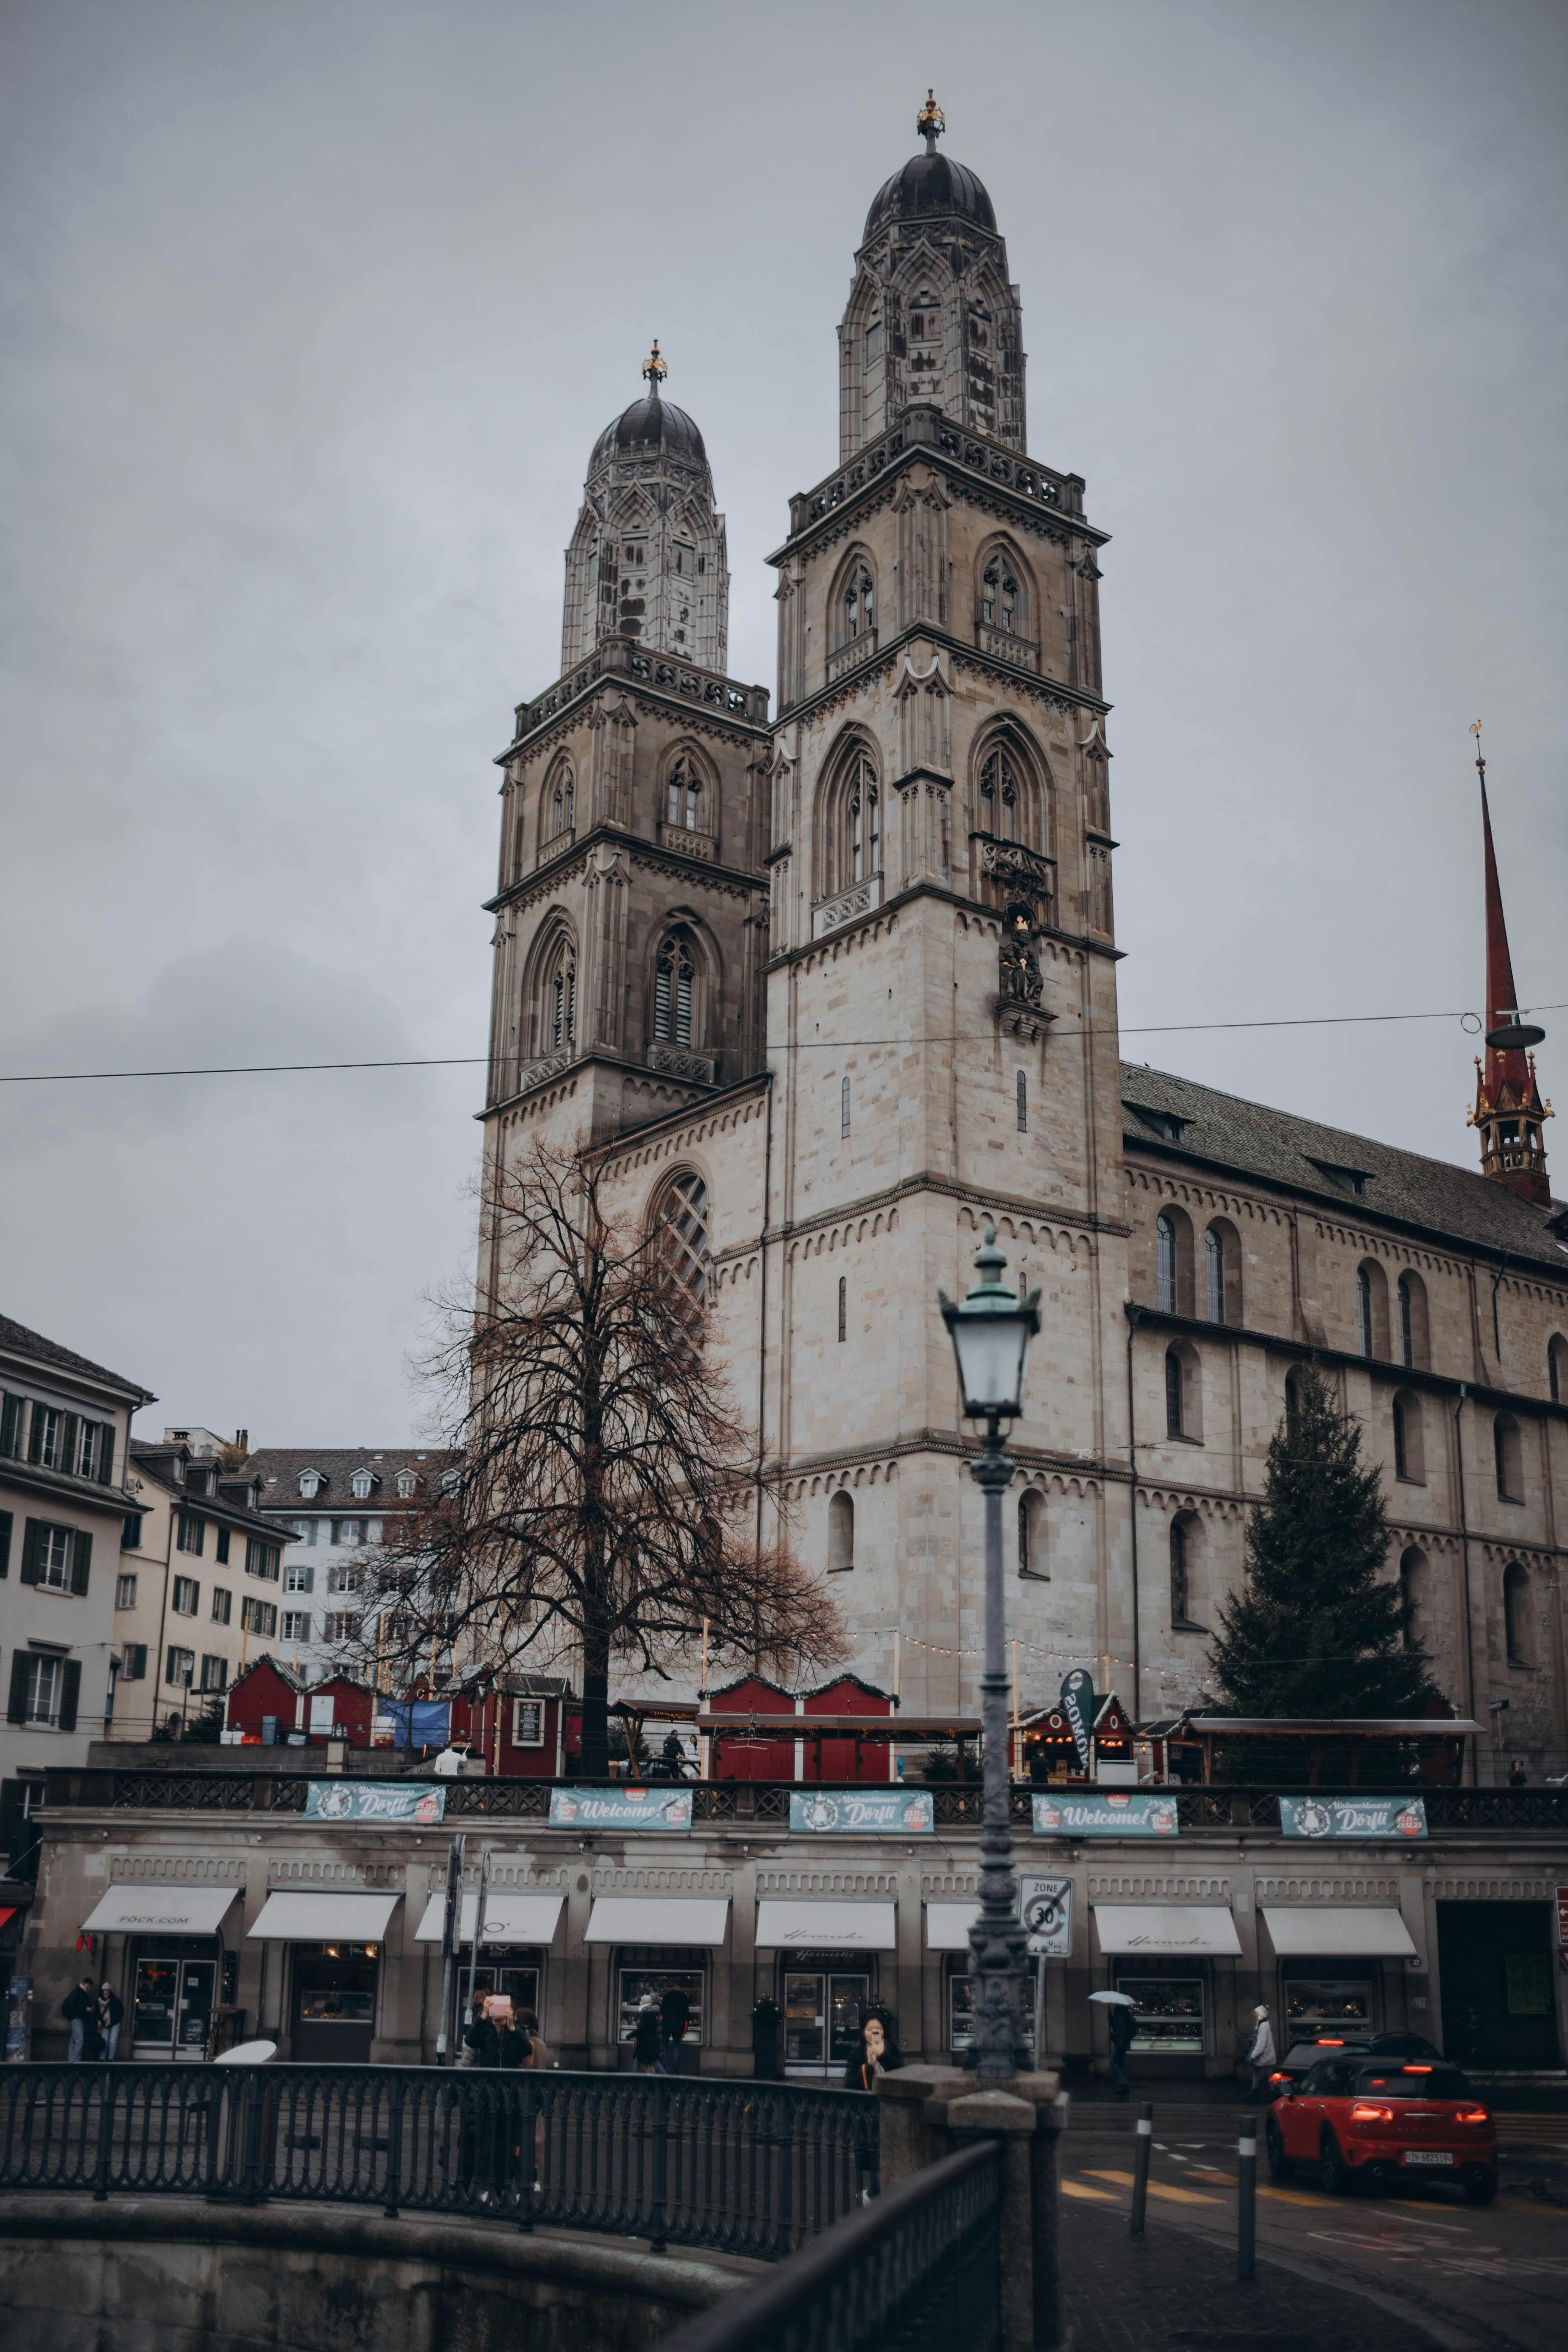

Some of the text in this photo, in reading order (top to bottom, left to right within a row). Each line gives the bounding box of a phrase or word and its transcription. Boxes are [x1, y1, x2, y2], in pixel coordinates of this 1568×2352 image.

[359, 1794, 408, 1815] Dörfli
[580, 1800, 665, 1819] Welcome!
[666, 1807, 681, 1815] Fire
[845, 1802, 896, 1824] Dörfli
[1332, 1801, 1391, 1810] Weihnachtsmarkt
[1063, 1806, 1150, 1825] Welcome!
[1151, 1814, 1167, 1823] Fire
[1336, 1809, 1388, 1830] Dörfli
[1034, 1883, 1058, 1893] ZONE
[119, 1915, 189, 1923] FÖCK.COM
[1036, 1907, 1054, 1924] 30
